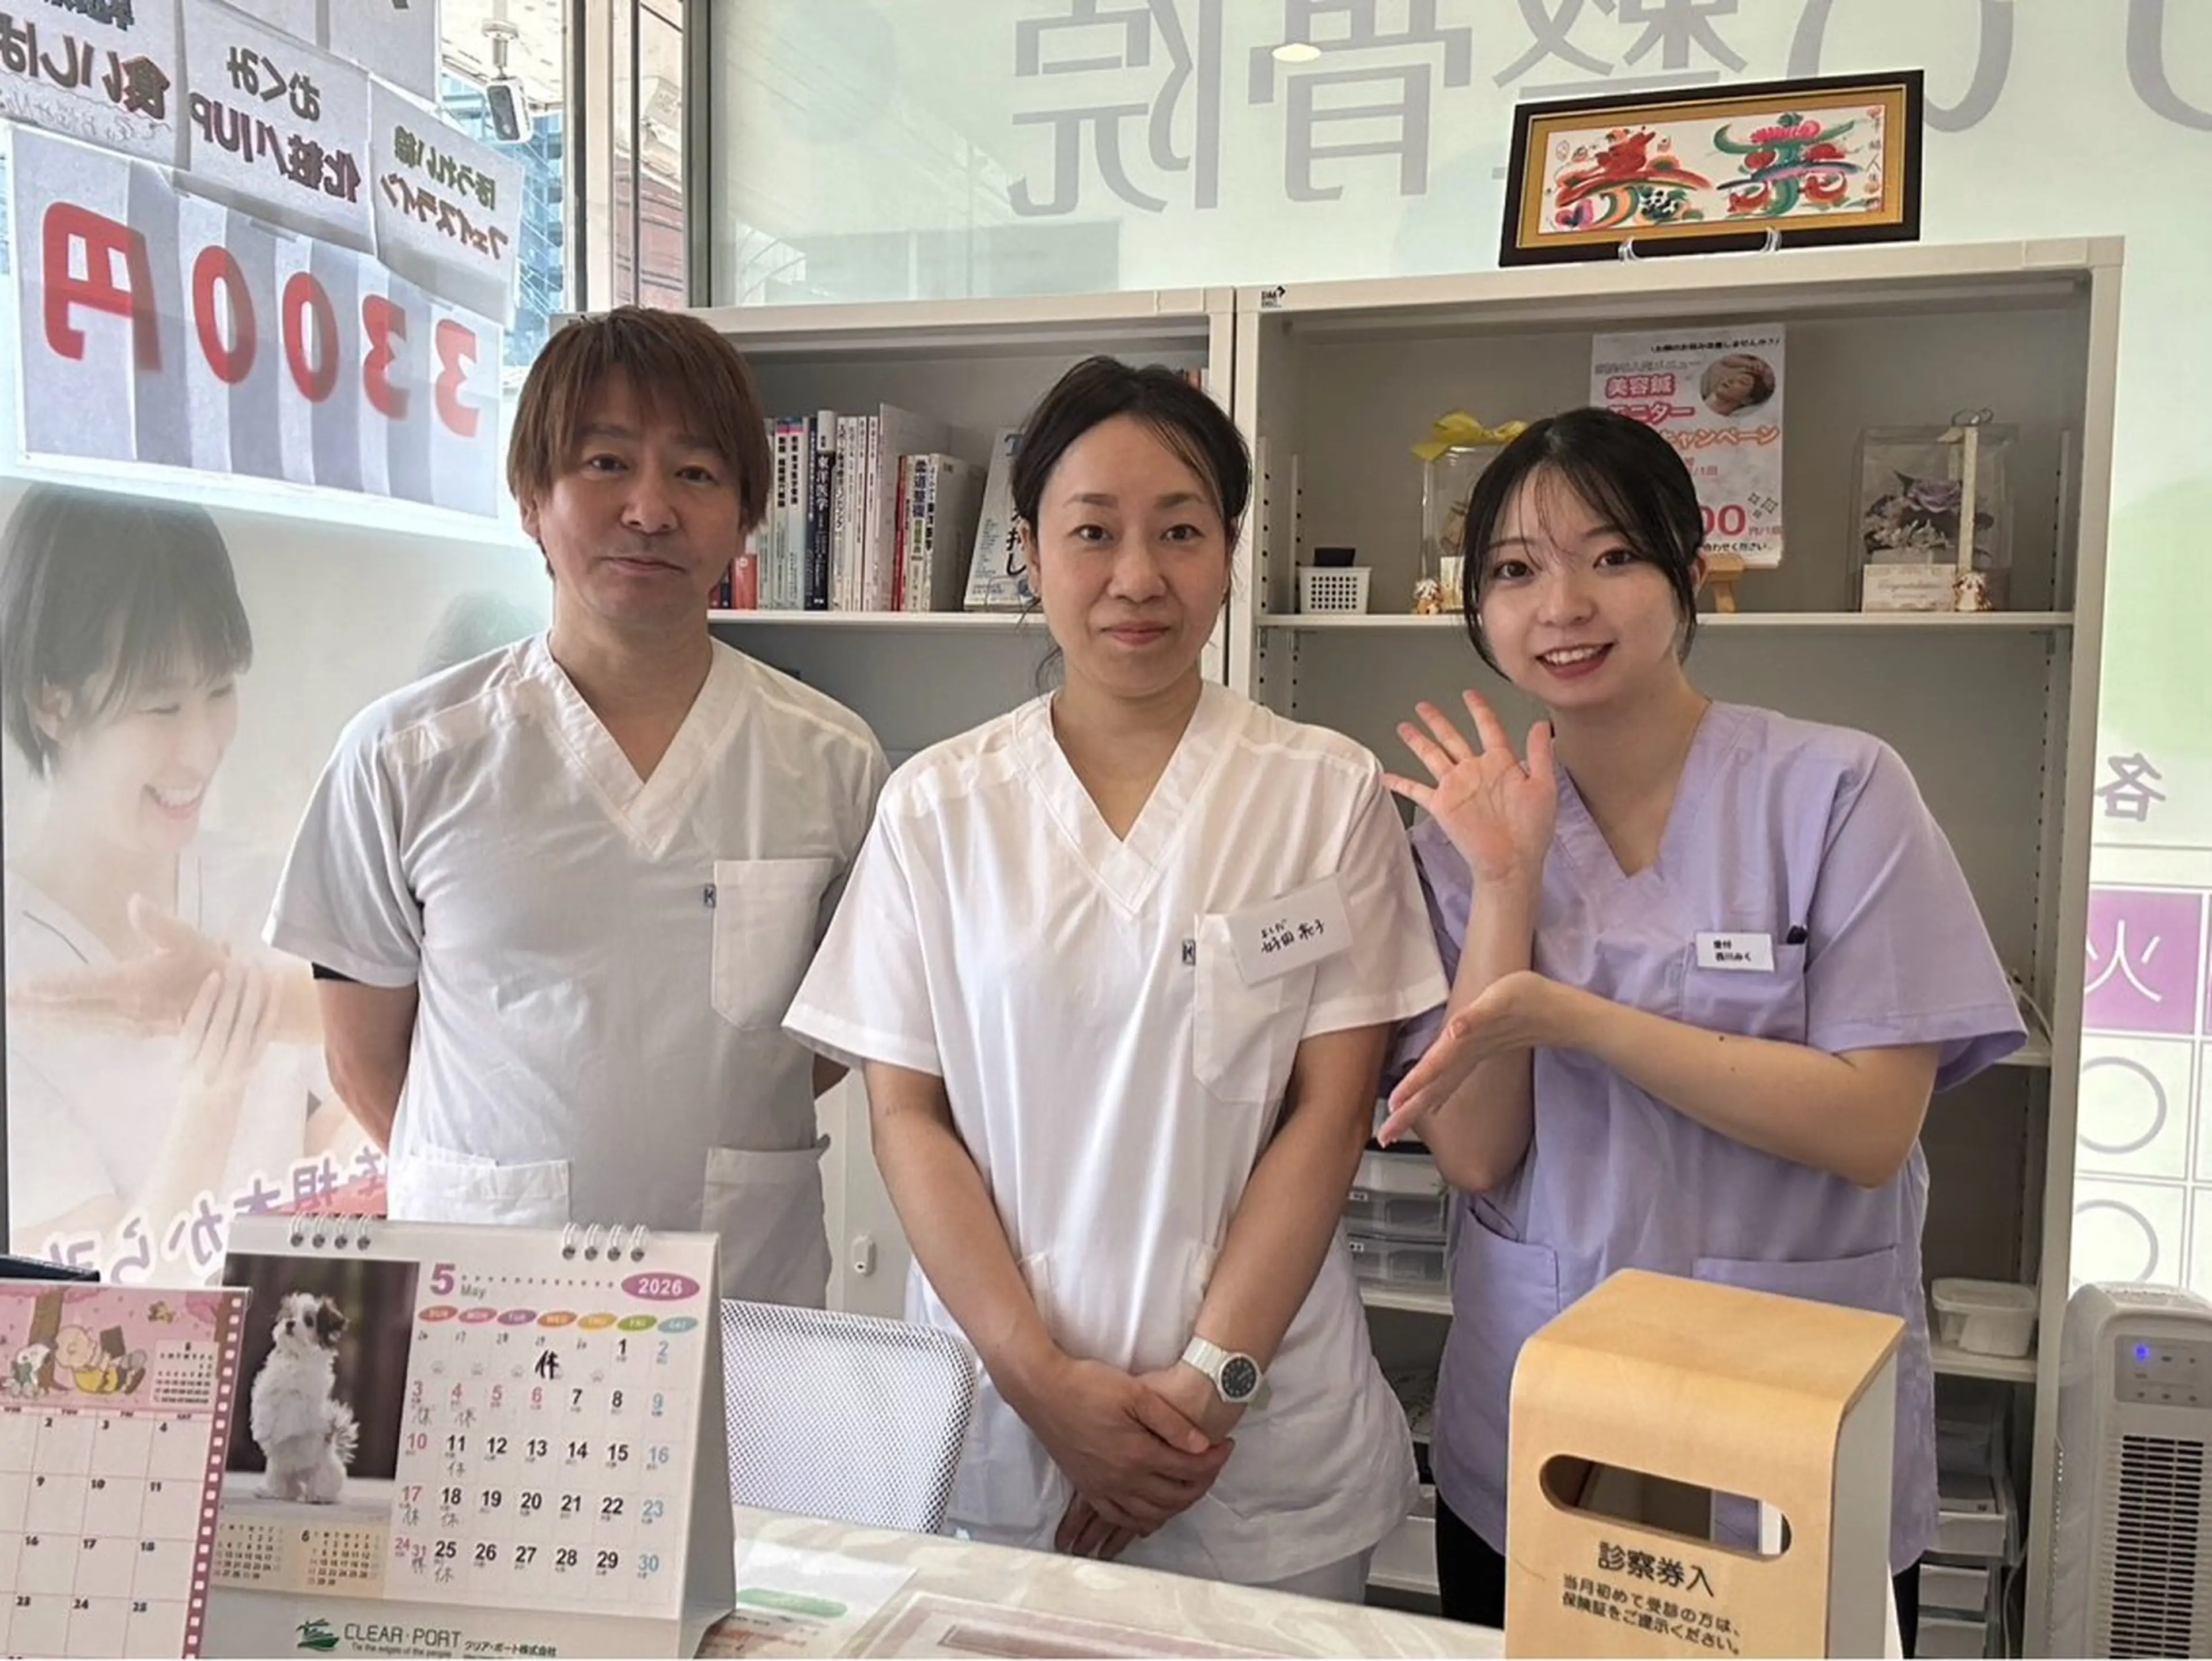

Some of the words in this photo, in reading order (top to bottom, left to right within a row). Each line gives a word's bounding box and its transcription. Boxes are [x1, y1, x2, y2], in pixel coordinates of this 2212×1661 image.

[430, 1263, 456, 1295] 5
[638, 1278, 682, 1295] 2026
[461, 1284, 486, 1299] May
[618, 1339, 627, 1354] 1
[658, 1342, 669, 1357] 2
[535, 1349, 559, 1380] 休
[412, 1380, 423, 1397] 3
[452, 1383, 462, 1399] 4
[491, 1384, 502, 1401] 5
[532, 1386, 542, 1403] 6
[572, 1389, 582, 1406] 7
[612, 1391, 623, 1407] 8
[652, 1393, 664, 1410] 9
[45, 1418, 52, 1427] 2
[102, 1420, 109, 1430] 3
[160, 1422, 168, 1432] 4
[406, 1433, 427, 1450] 10
[447, 1435, 465, 1451] 11
[487, 1437, 507, 1454] 12
[527, 1439, 547, 1456] 13
[568, 1441, 588, 1459] 14
[608, 1444, 629, 1462] 15
[649, 1447, 669, 1465] 16
[37, 1477, 45, 1486] 9
[91, 1479, 105, 1489] 10
[150, 1482, 162, 1492] 11
[403, 1486, 422, 1503] 17
[441, 1488, 461, 1504] 18
[482, 1490, 502, 1507] 19
[521, 1492, 542, 1509] 20
[560, 1495, 581, 1512] 21
[601, 1497, 624, 1515] 22
[642, 1500, 664, 1518] 23
[25, 1536, 39, 1546] 16
[82, 1539, 97, 1549] 17
[141, 1542, 155, 1552] 18
[394, 1538, 410, 1552] 24
[435, 1541, 456, 1558] 25
[475, 1543, 497, 1561] 26
[516, 1546, 536, 1564] 27
[555, 1549, 577, 1566] 28
[597, 1551, 618, 1569] 29
[638, 1554, 660, 1572] 30
[1598, 1541, 1714, 1598] 診察券入
[17, 1596, 31, 1606] 23
[73, 1599, 89, 1609] 24
